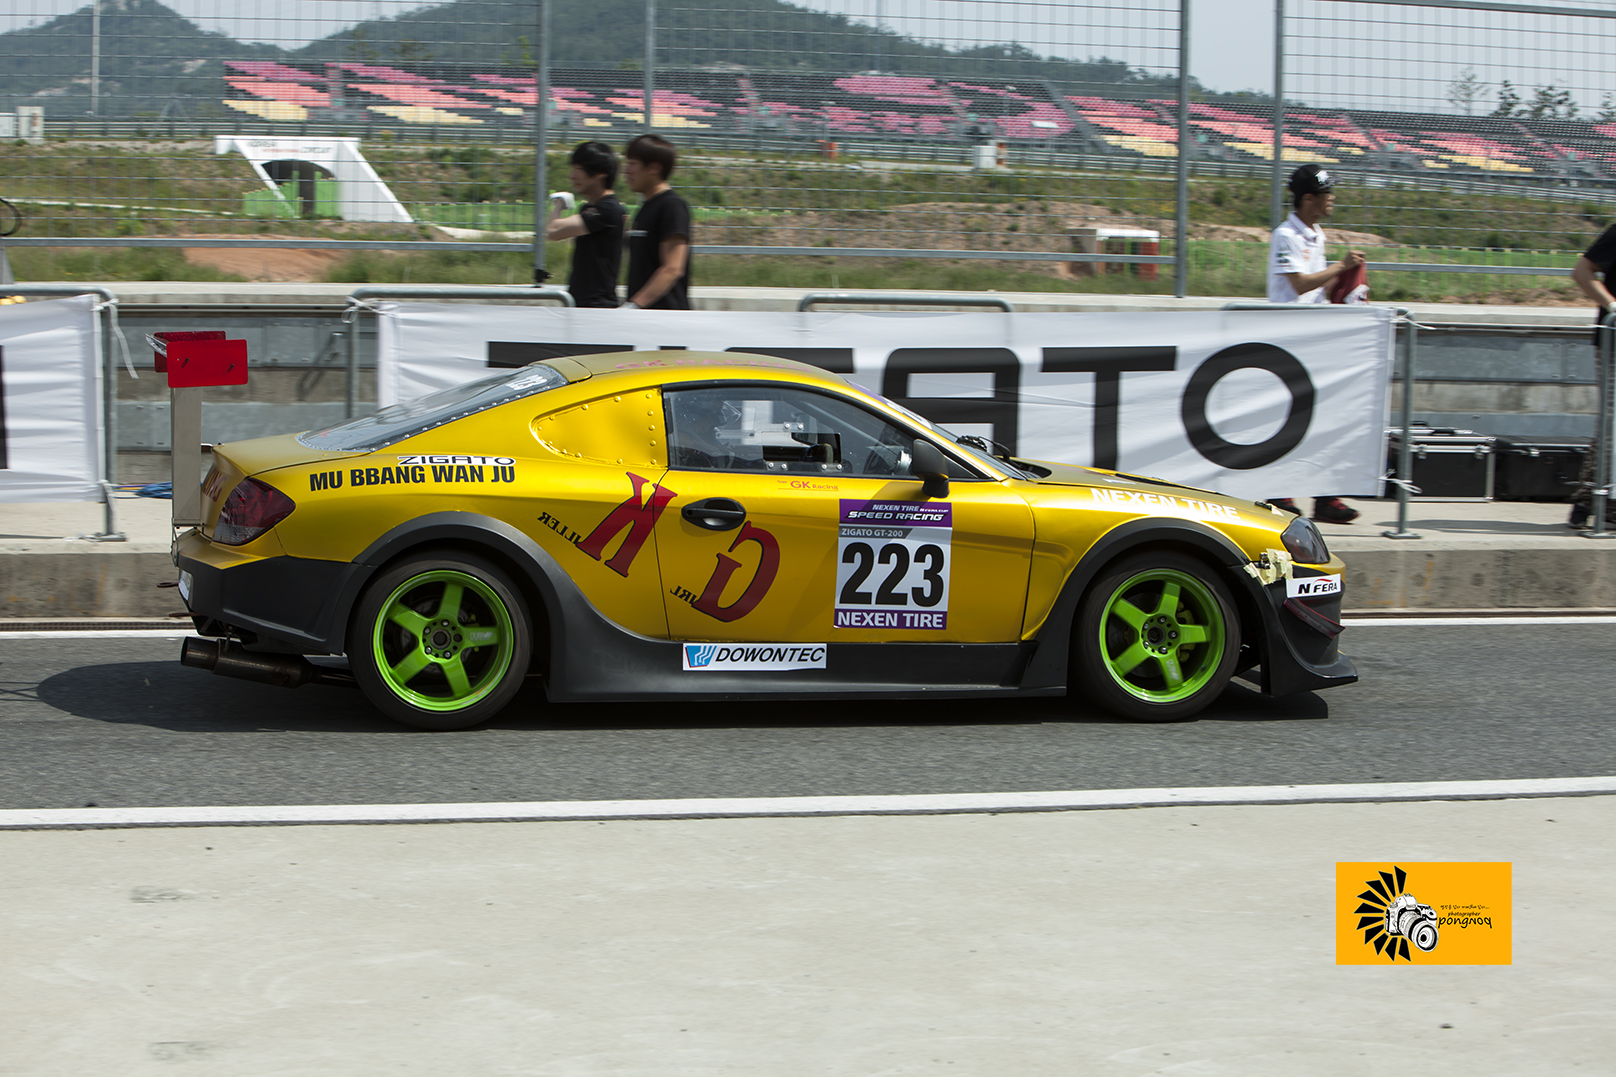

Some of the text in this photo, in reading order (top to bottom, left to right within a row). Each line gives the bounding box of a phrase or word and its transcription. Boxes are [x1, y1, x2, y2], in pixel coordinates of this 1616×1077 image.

[397, 454, 516, 467] ZIGATO
[309, 465, 516, 492] MU BBANG WAN JU
[790, 480, 811, 489] GK
[1090, 487, 1241, 520] NEXEN TIRE
[847, 511, 945, 521] SPEED RACING
[841, 528, 904, 537] ZIGATO GT-200
[839, 541, 945, 608] 223
[837, 611, 943, 628] NEXEN TIRE
[715, 647, 826, 662] DOWONTEC
